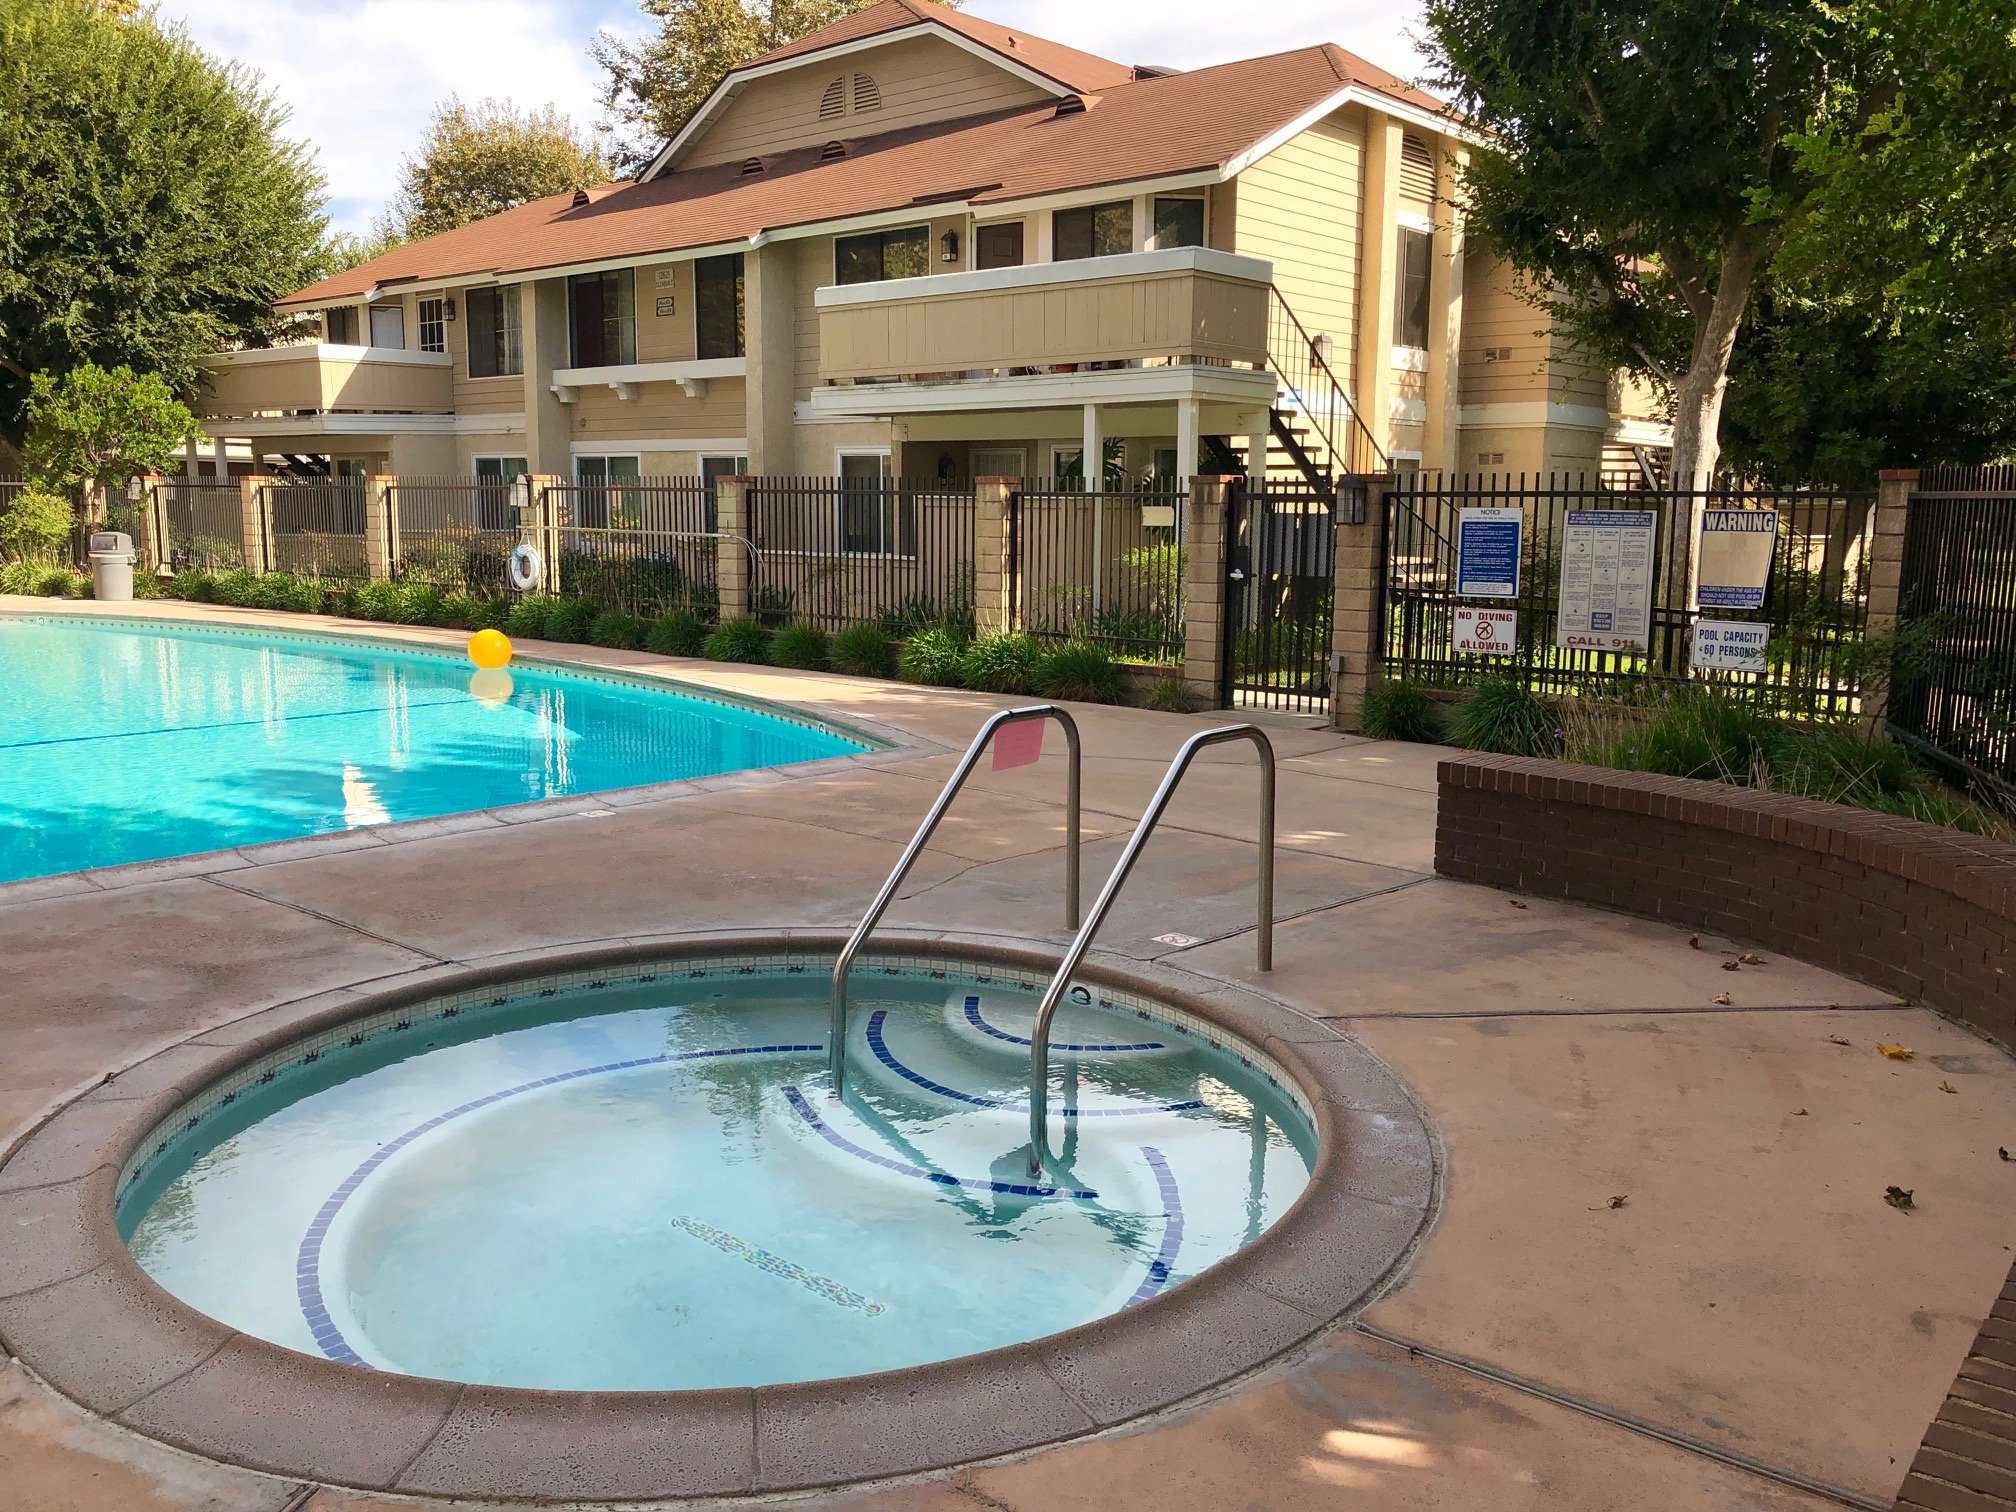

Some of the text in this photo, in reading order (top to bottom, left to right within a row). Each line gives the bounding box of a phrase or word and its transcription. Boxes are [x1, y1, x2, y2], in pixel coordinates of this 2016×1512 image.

[1706, 513, 1773, 531] WARNING
[1458, 611, 1513, 622] NO DIVING
[1567, 636, 1635, 649] CALL 911
[1699, 629, 1763, 644] POOL CAPACITY
[1460, 640, 1509, 651] ALLOWED
[1704, 644, 1756, 658] 60 PERSONS
